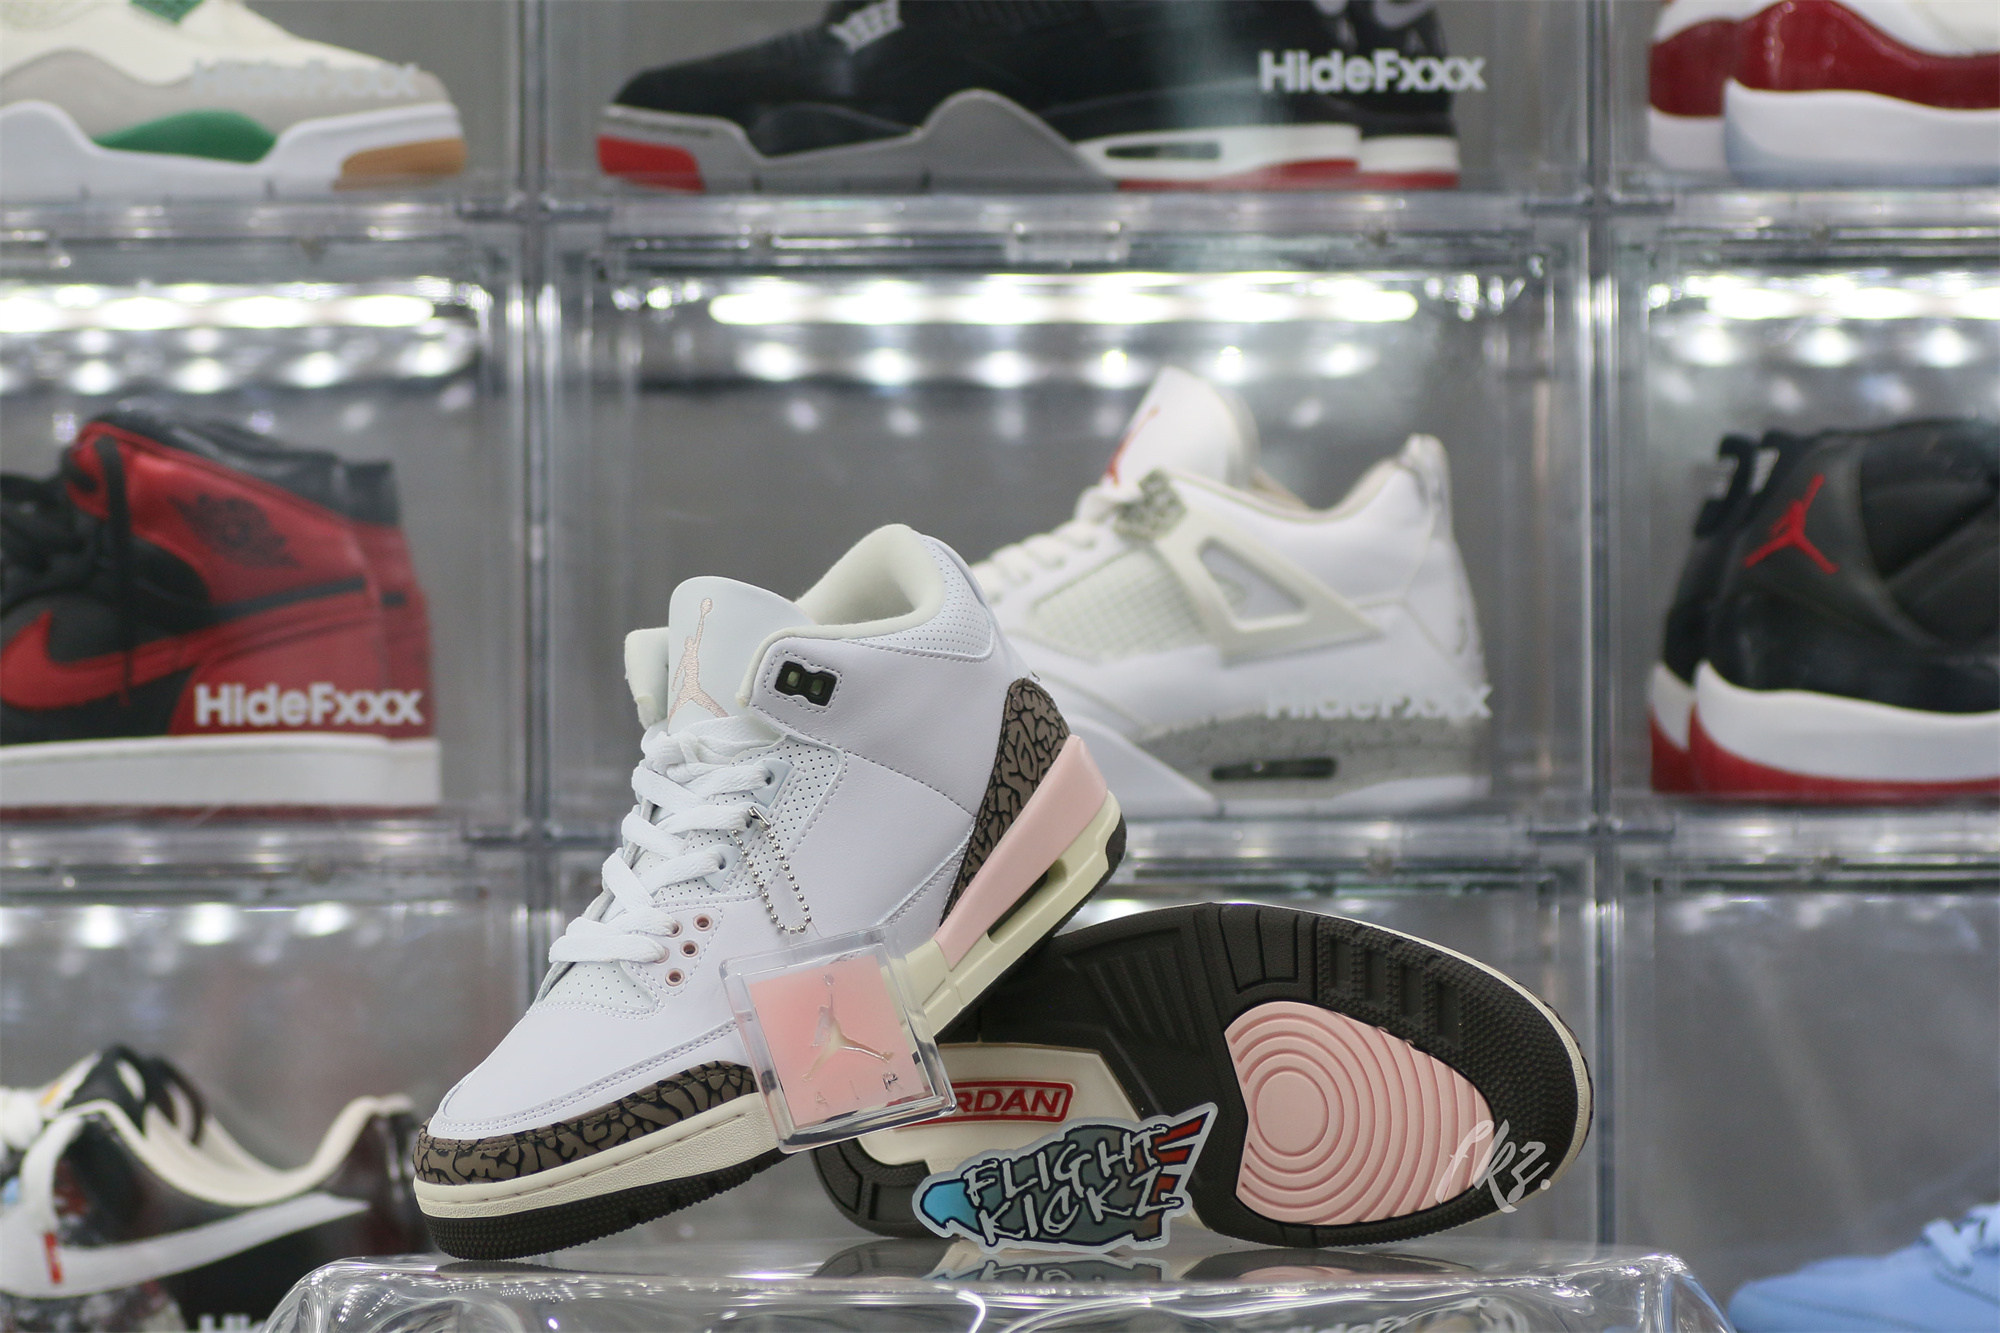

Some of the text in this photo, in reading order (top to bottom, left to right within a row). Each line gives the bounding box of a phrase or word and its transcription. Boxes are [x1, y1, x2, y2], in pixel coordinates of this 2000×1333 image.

[1259, 49, 1488, 92] HideFxxx
[194, 682, 425, 726] HideFxxx
[955, 1088, 1062, 1113] RDAN
[963, 1124, 1168, 1206] FLIGHT
[978, 1166, 1184, 1245] KICKZ
